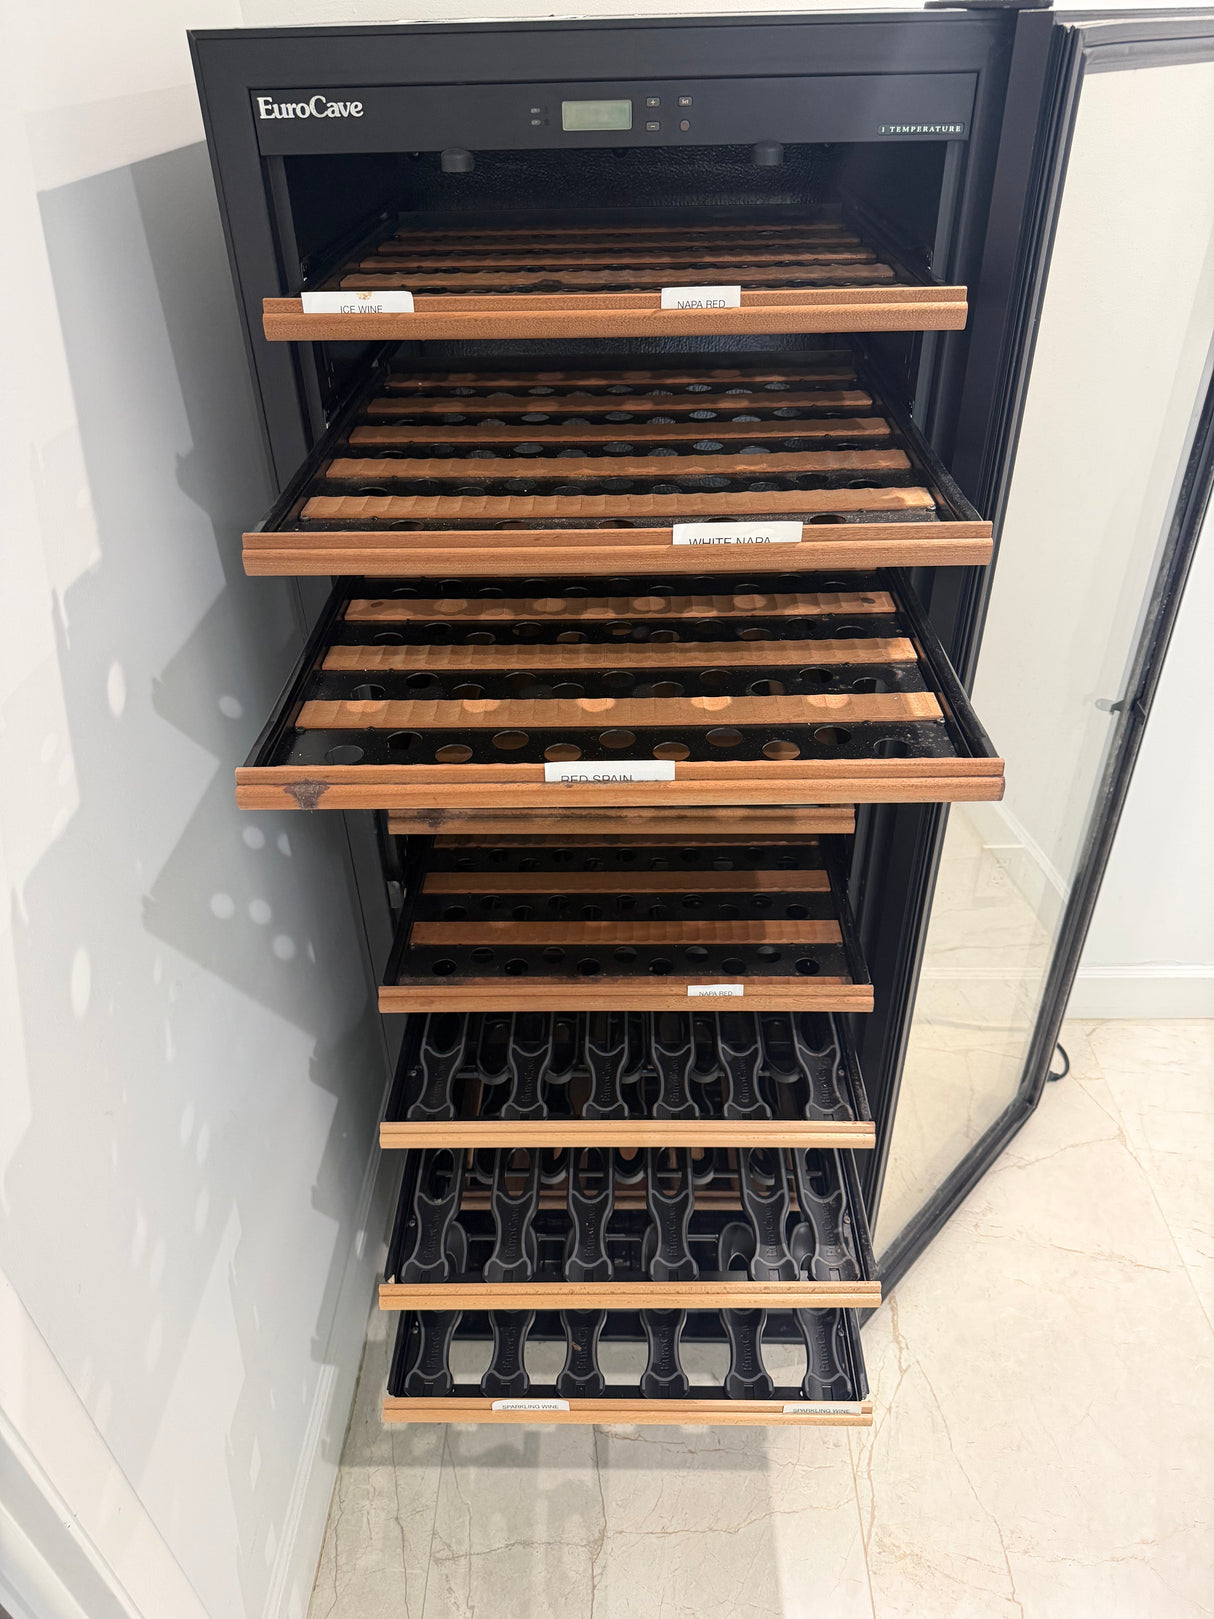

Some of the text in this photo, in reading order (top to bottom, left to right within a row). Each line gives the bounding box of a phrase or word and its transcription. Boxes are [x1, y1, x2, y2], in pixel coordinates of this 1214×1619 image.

[256, 95, 364, 119] EuroCave
[889, 125, 961, 133] TEMPERATURE
[677, 300, 726, 309] NAPA RED
[340, 305, 383, 313] ICE WINE
